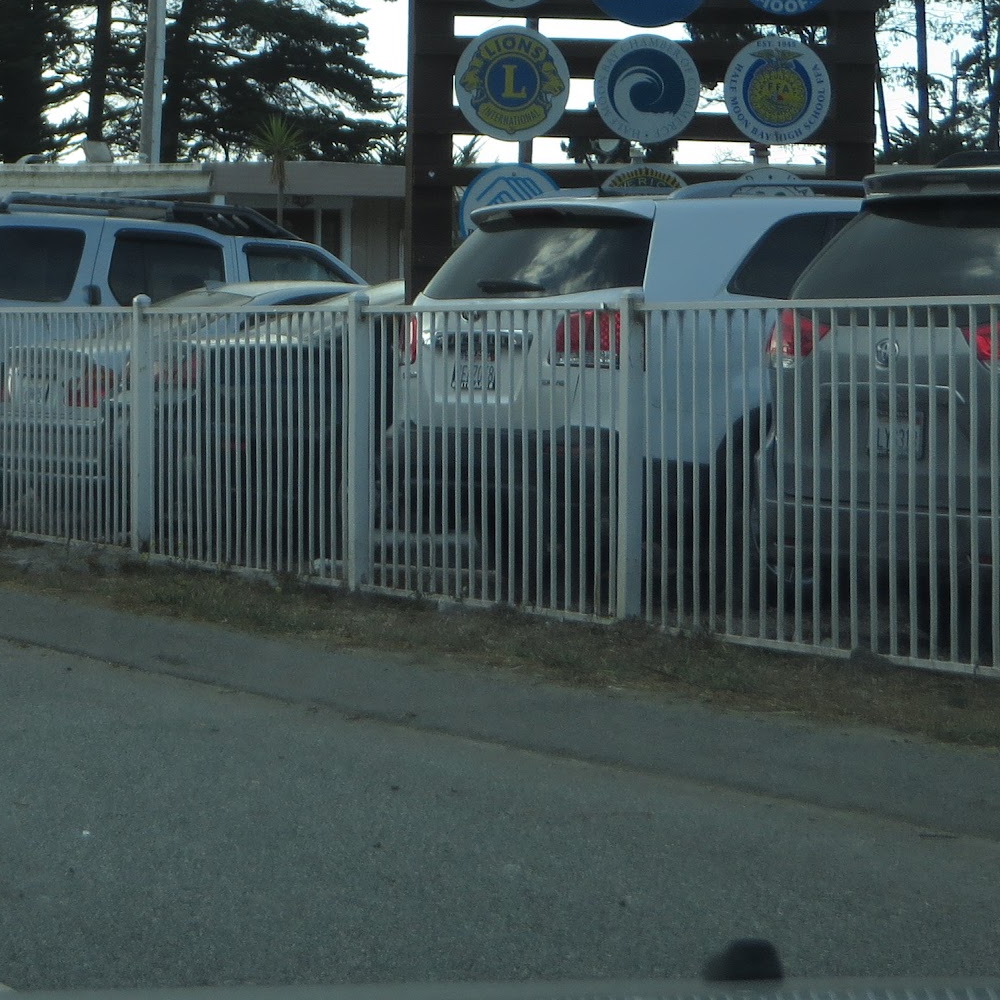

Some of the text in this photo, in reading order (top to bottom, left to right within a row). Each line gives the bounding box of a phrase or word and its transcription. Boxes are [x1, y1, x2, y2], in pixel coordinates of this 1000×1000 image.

[484, 37, 544, 60] LIONS
[502, 64, 527, 98] L
[730, 63, 744, 90] HALF
[482, 106, 540, 126] INTERNATIONAL
[731, 97, 751, 128] MOON
[804, 88, 826, 129] SCHOOL
[751, 128, 770, 140] BAY
[775, 128, 802, 141] HIGH
